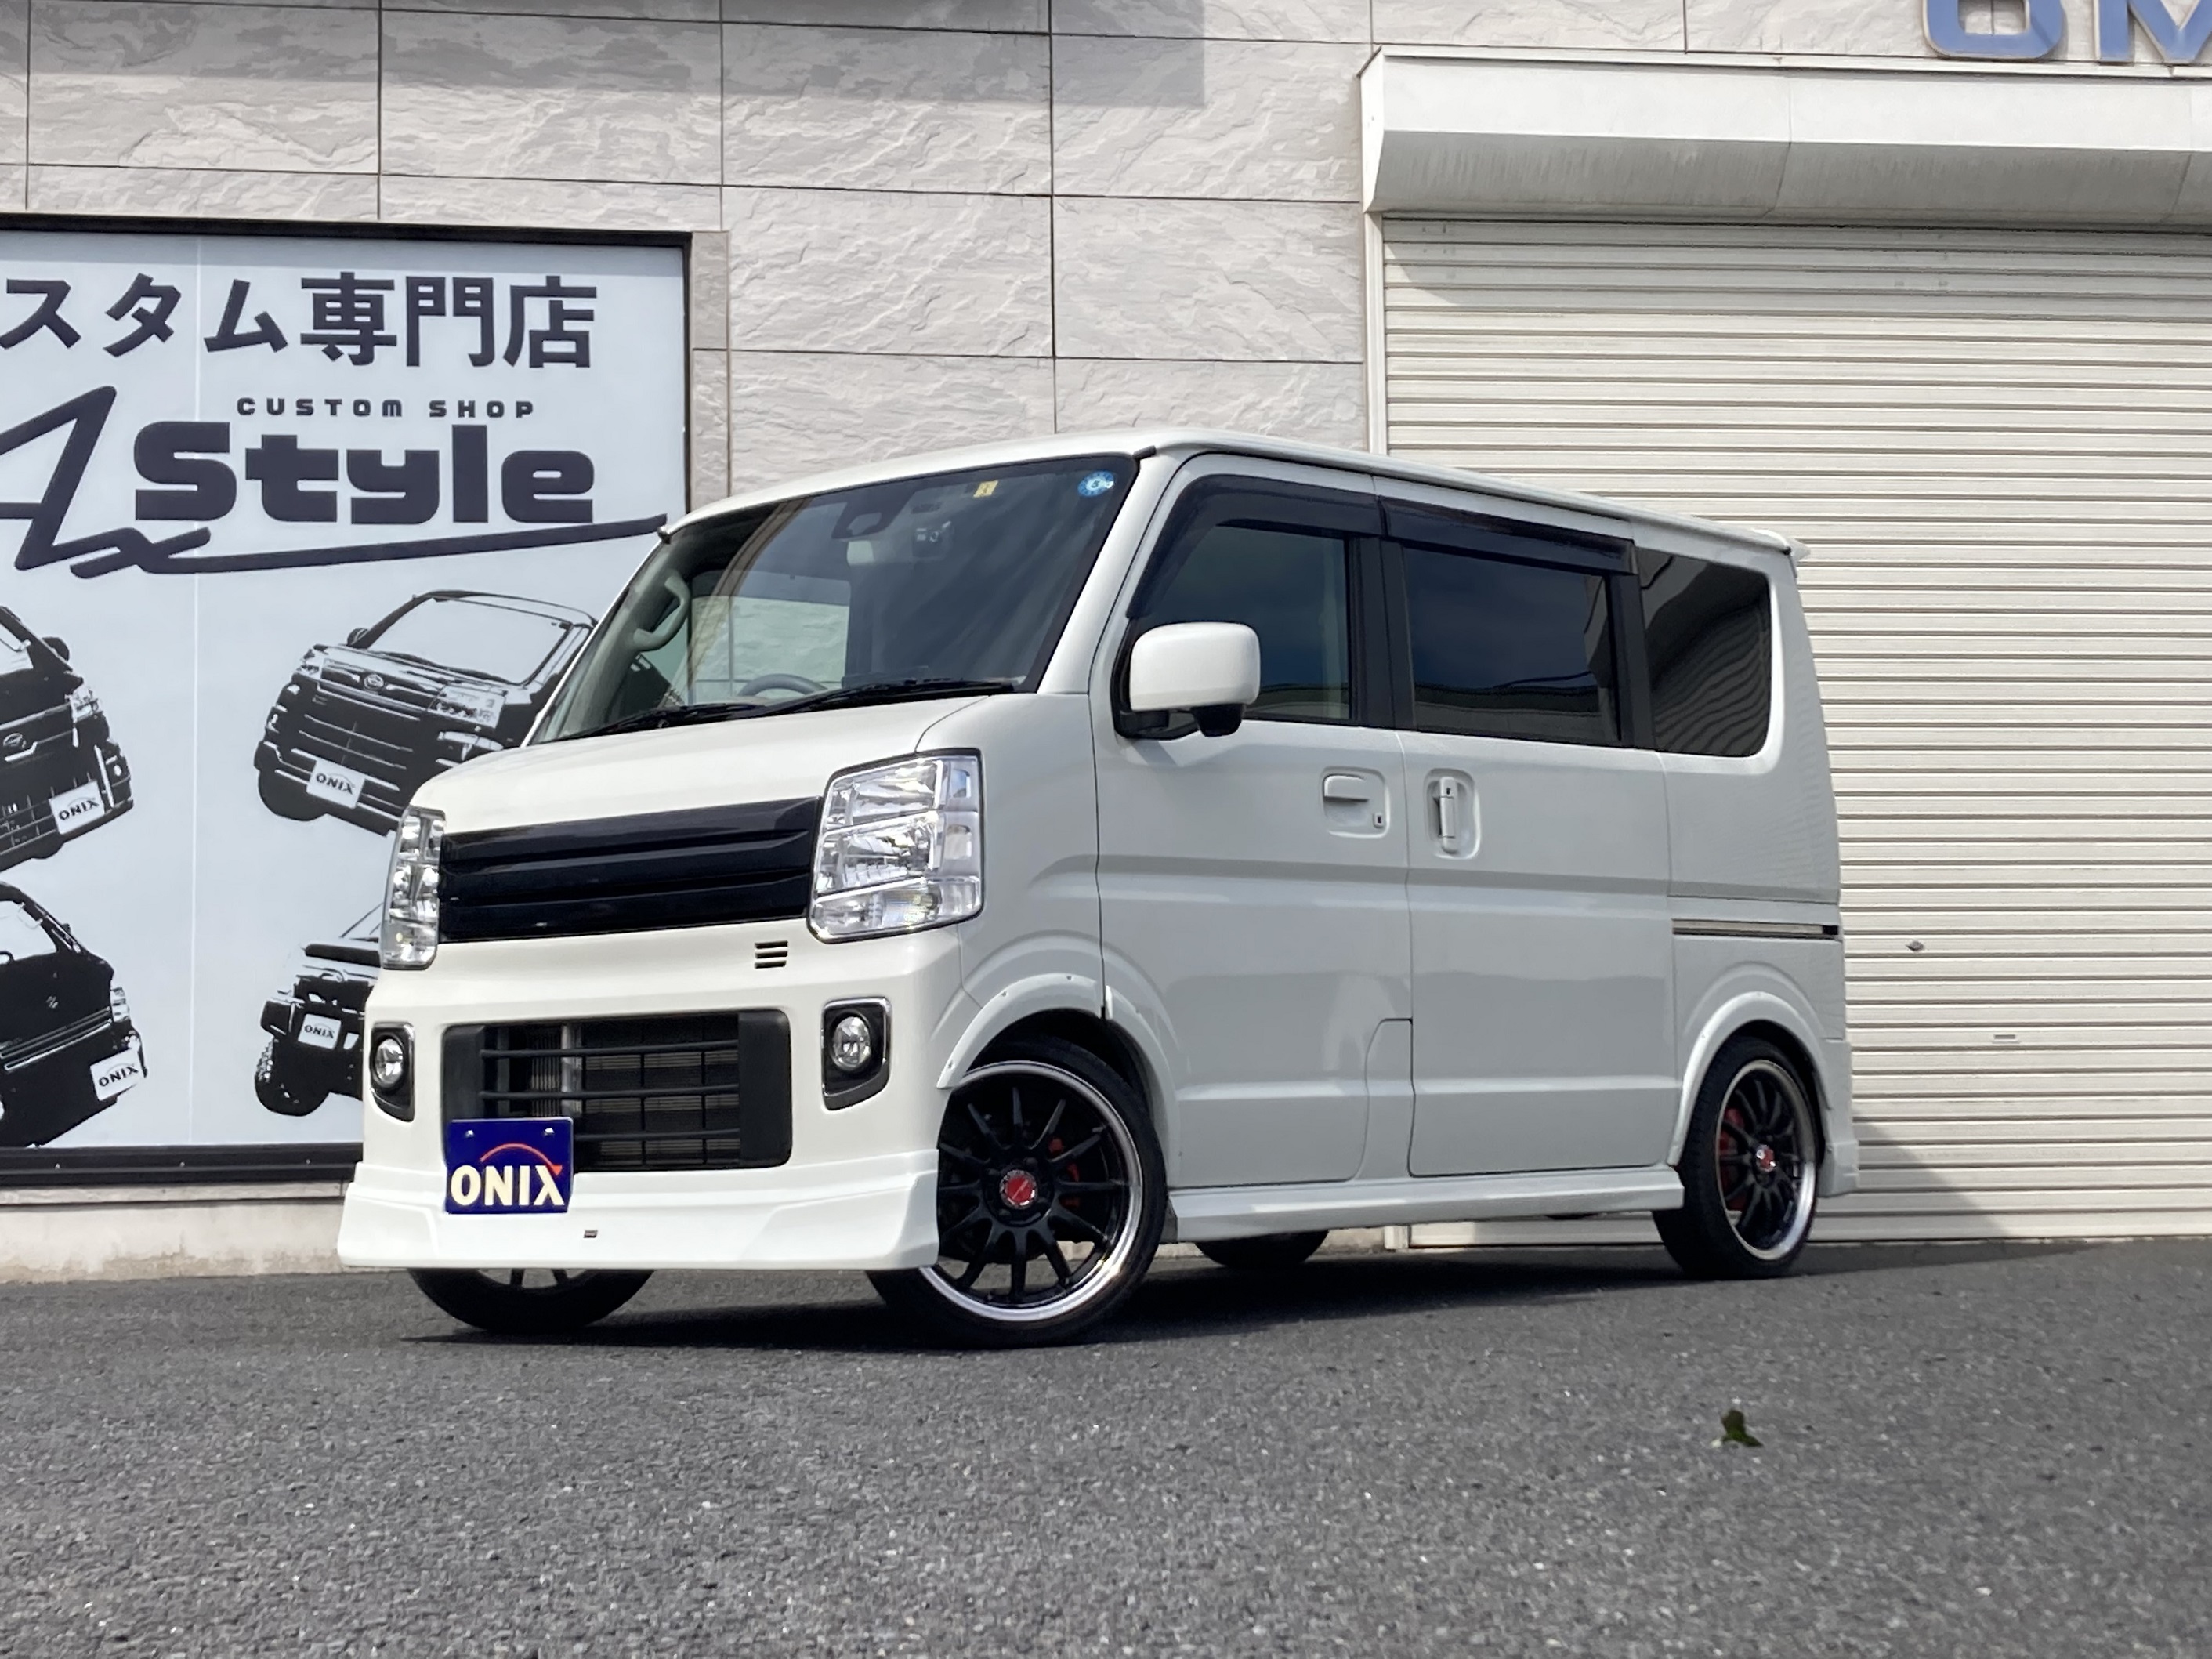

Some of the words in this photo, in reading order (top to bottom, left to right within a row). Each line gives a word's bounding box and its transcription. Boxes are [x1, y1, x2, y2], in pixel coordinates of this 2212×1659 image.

[0, 271, 598, 369] スタム専門店
[237, 397, 402, 418] CUSTOM
[429, 400, 534, 418] SHOP
[316, 773, 353, 795] ONIX
[59, 799, 100, 820] ONIX
[304, 1025, 334, 1039] ONIX
[99, 1066, 139, 1087] ONIX
[451, 1165, 565, 1206] ONIX
